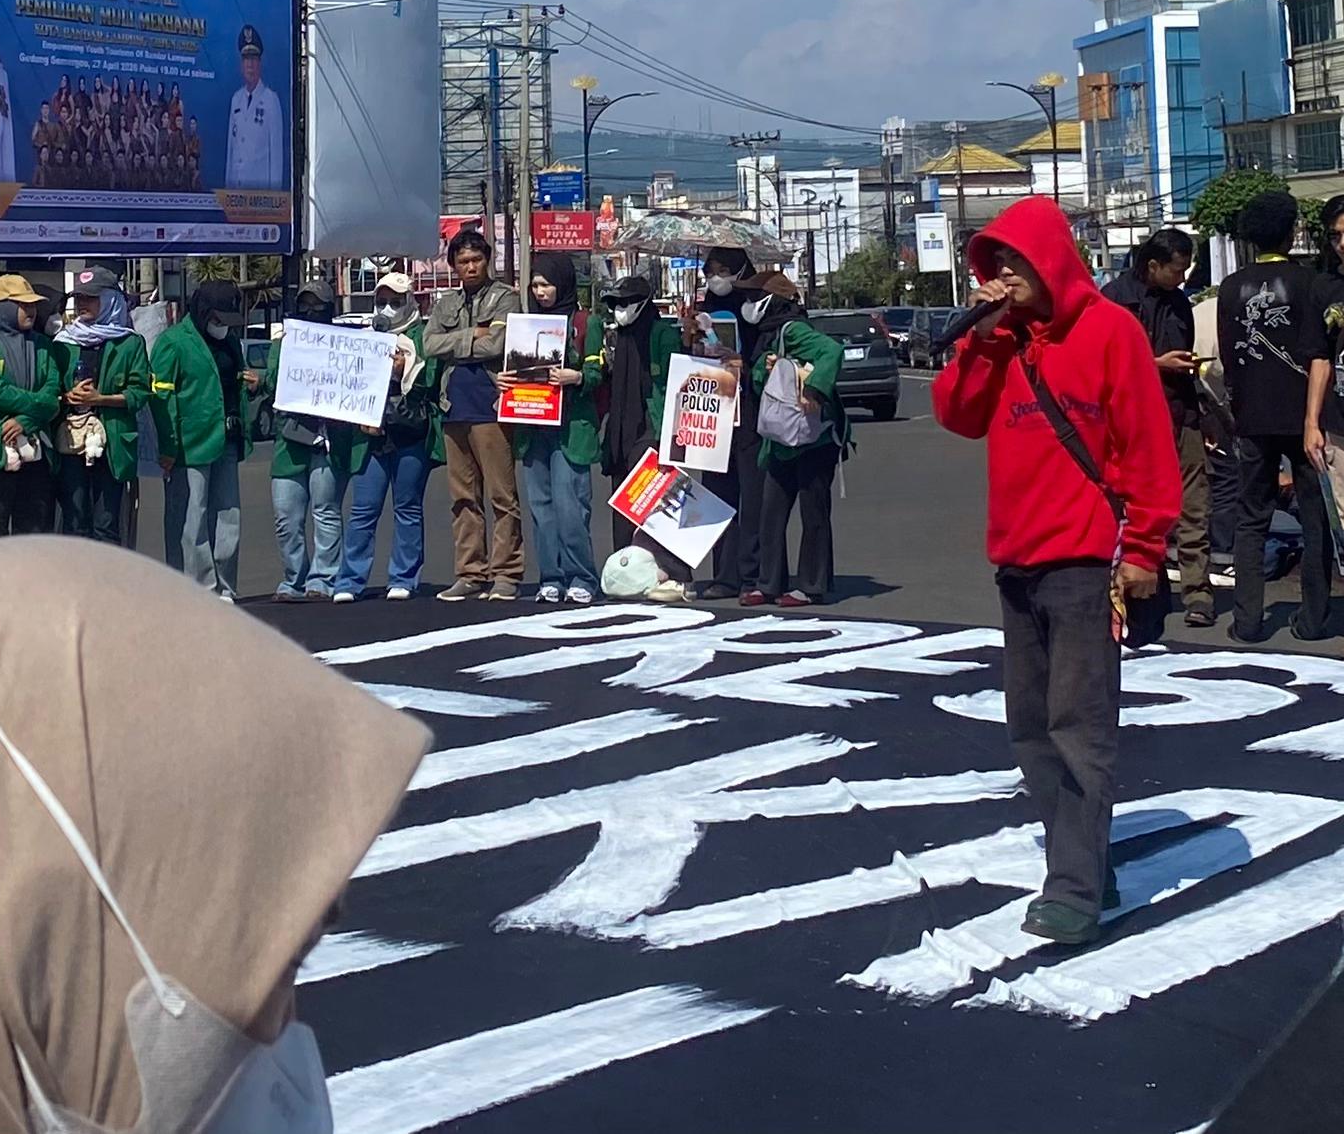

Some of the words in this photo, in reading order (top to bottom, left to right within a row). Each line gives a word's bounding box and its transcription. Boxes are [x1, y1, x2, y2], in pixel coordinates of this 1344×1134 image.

[100, 7, 135, 28] MULI
[139, 13, 205, 37] MEKHANAI
[688, 377, 718, 394] STOP
[681, 395, 720, 413] POLUSI
[681, 412, 718, 431] MULAI
[677, 429, 716, 448] SOLUSI
